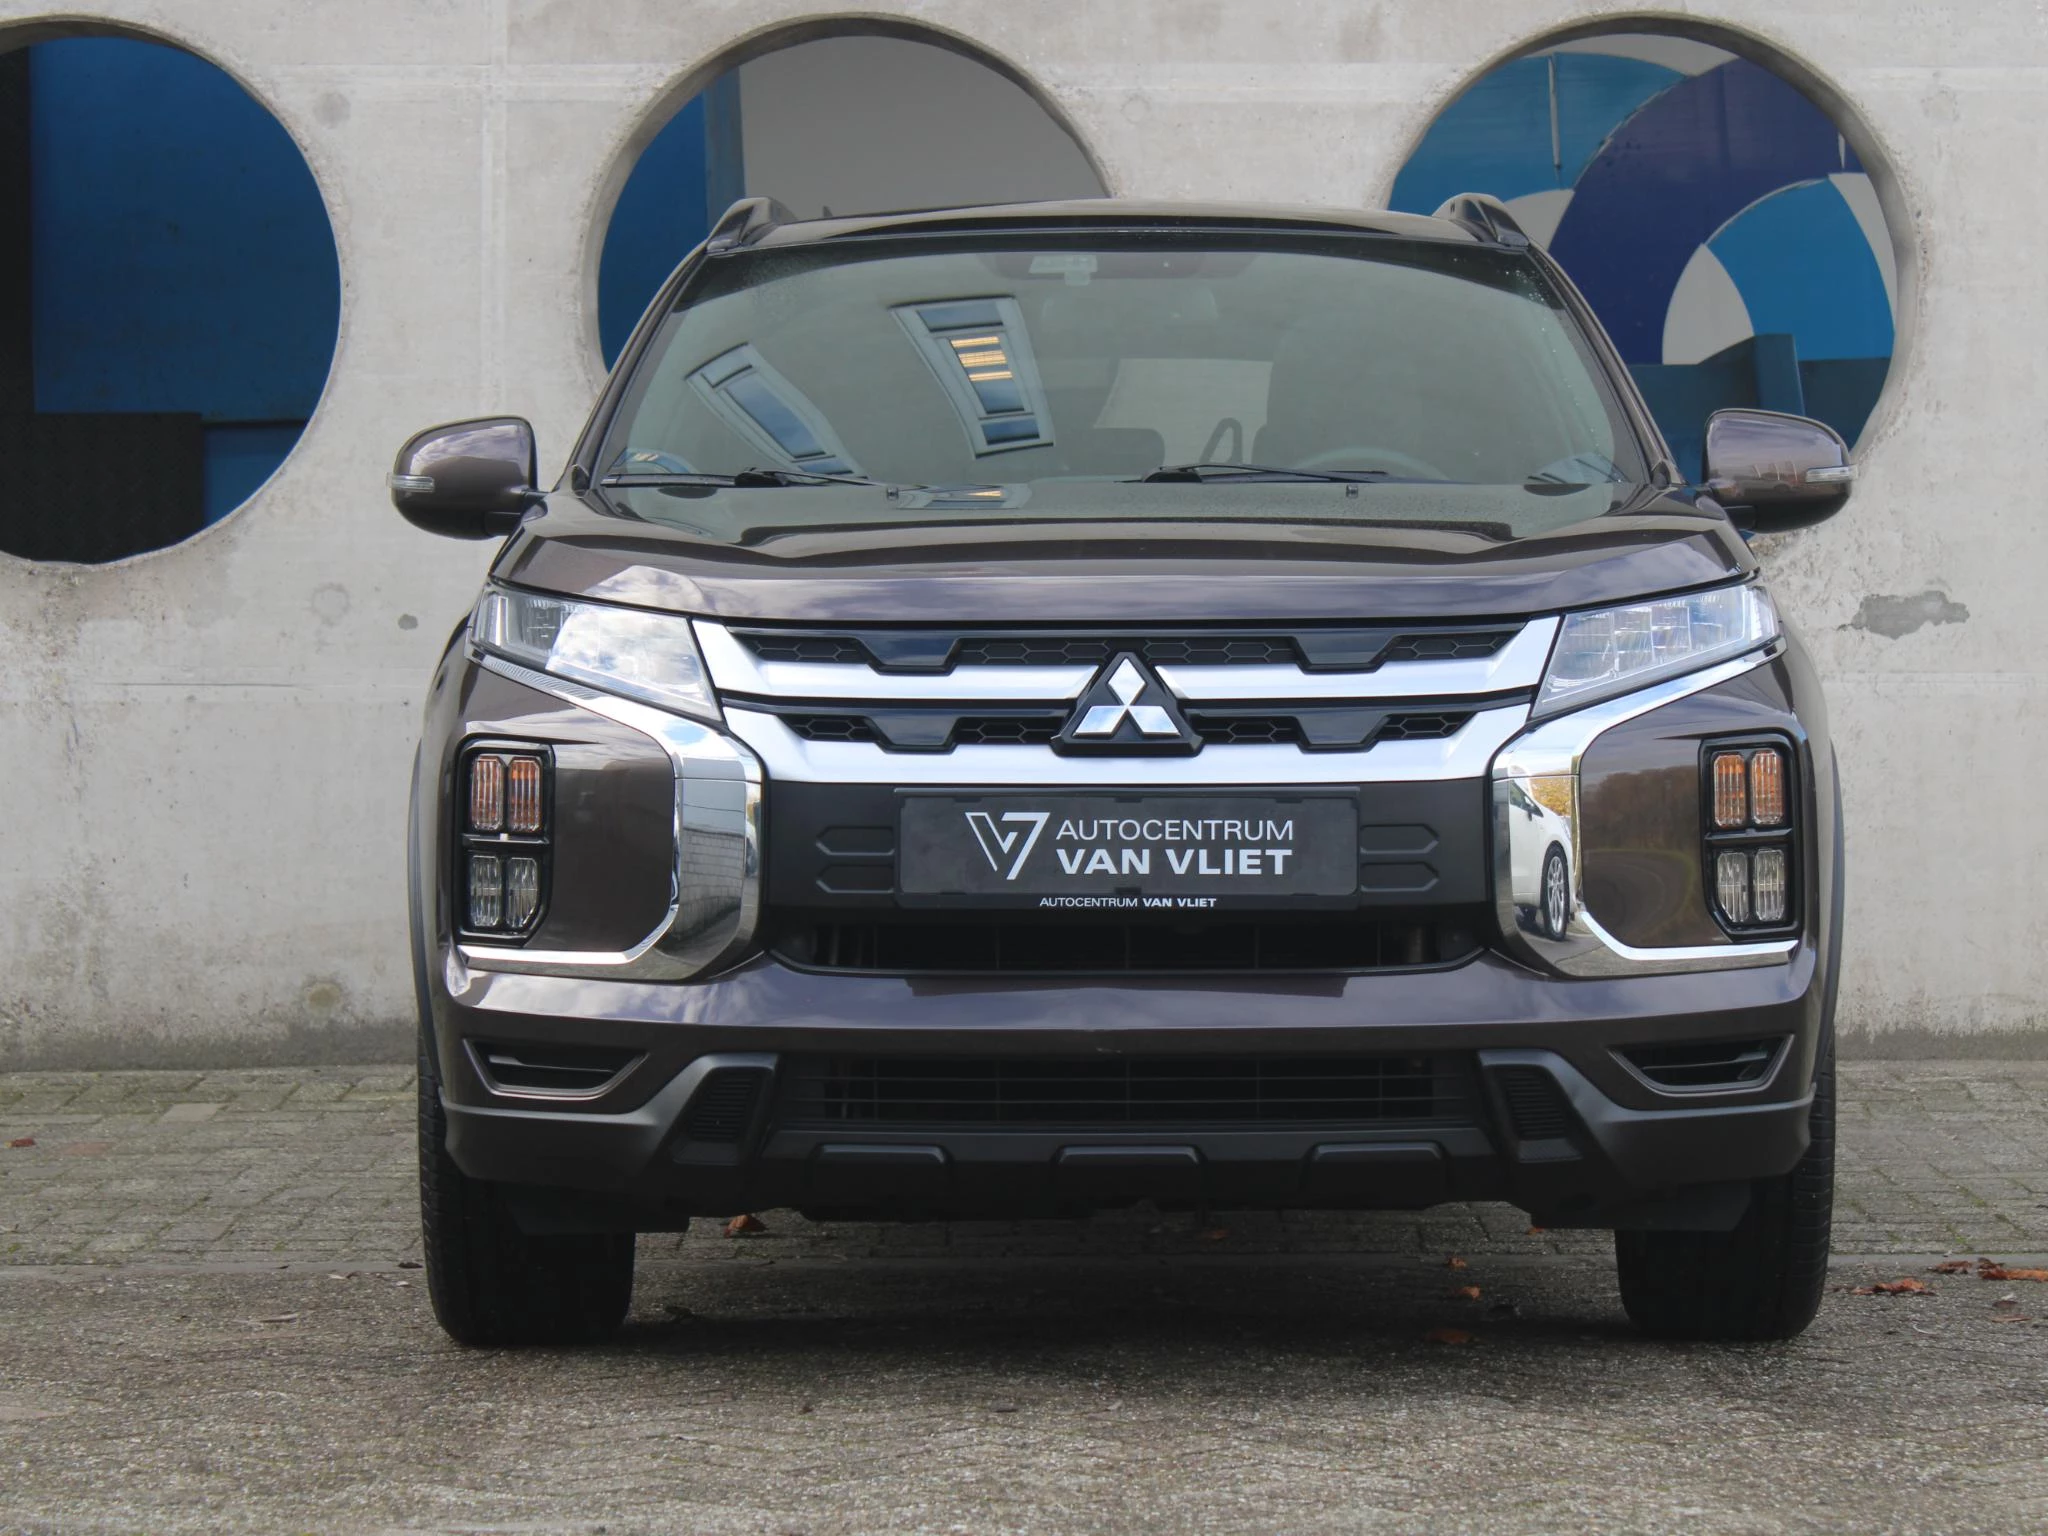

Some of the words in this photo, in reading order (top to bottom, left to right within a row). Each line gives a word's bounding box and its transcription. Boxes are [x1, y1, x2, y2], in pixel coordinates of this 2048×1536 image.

[1055, 818, 1295, 842] AUTOCENTRUM
[1056, 848, 1151, 876] VAN
[1165, 848, 1293, 876] VLIET
[1039, 897, 1138, 908] AUTOCENTRUM
[1142, 897, 1172, 908] VAN
[1176, 897, 1217, 908] VLIET
